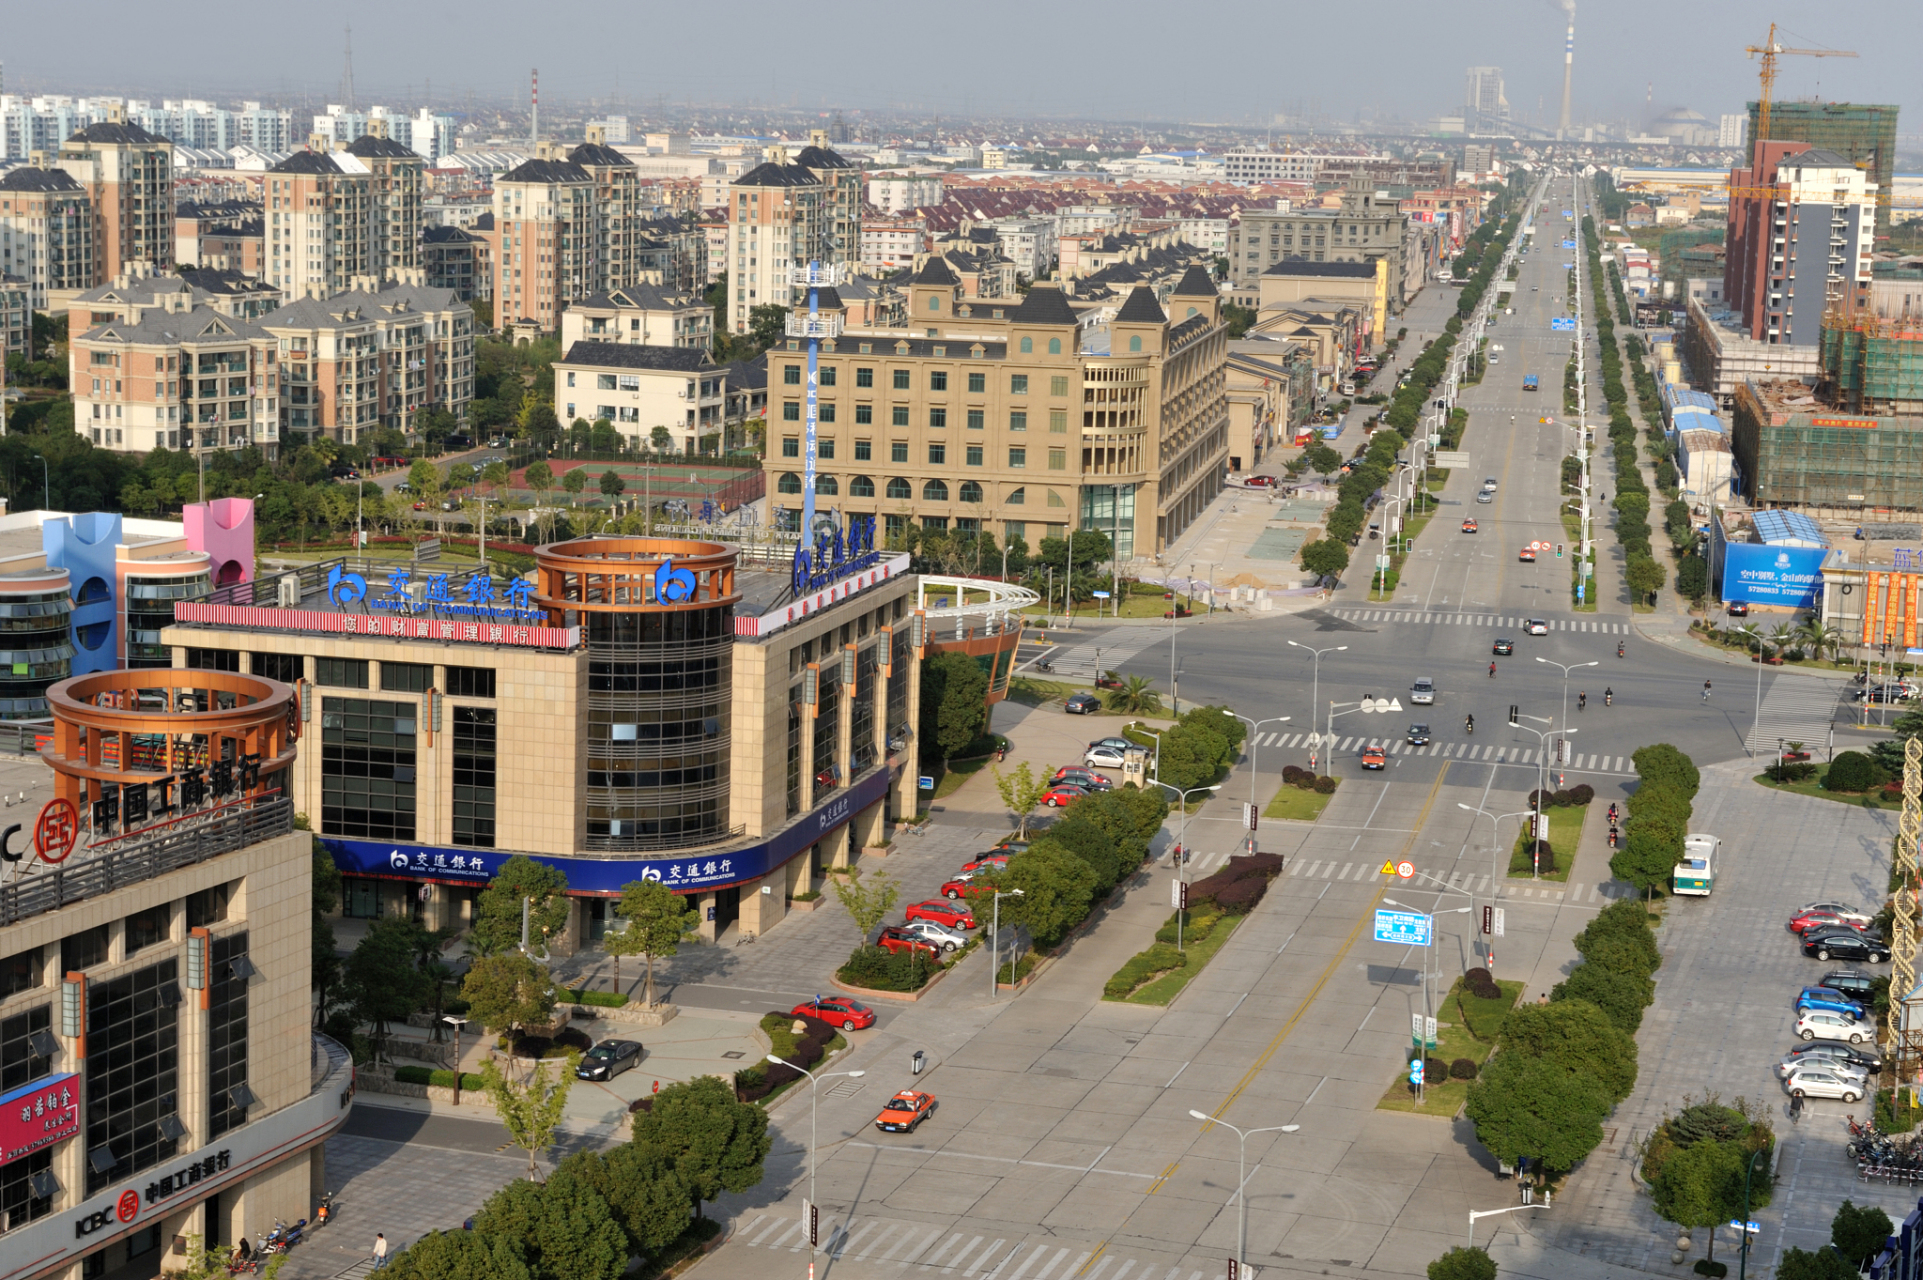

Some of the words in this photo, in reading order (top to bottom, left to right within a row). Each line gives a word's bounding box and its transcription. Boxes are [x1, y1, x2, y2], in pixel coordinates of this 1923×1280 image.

[371, 598, 404, 610] BANK
[412, 602, 430, 613] OF
[434, 603, 549, 620] COMMUNICATIONS
[92, 752, 261, 834] 中国工商银行
[438, 868, 489, 877] COMMUNICATIONS
[691, 872, 736, 884] COMMUNICATIONS
[1400, 865, 1411, 874] 30
[145, 1149, 231, 1204] 中国工商银行
[75, 1205, 114, 1240] ICBC
